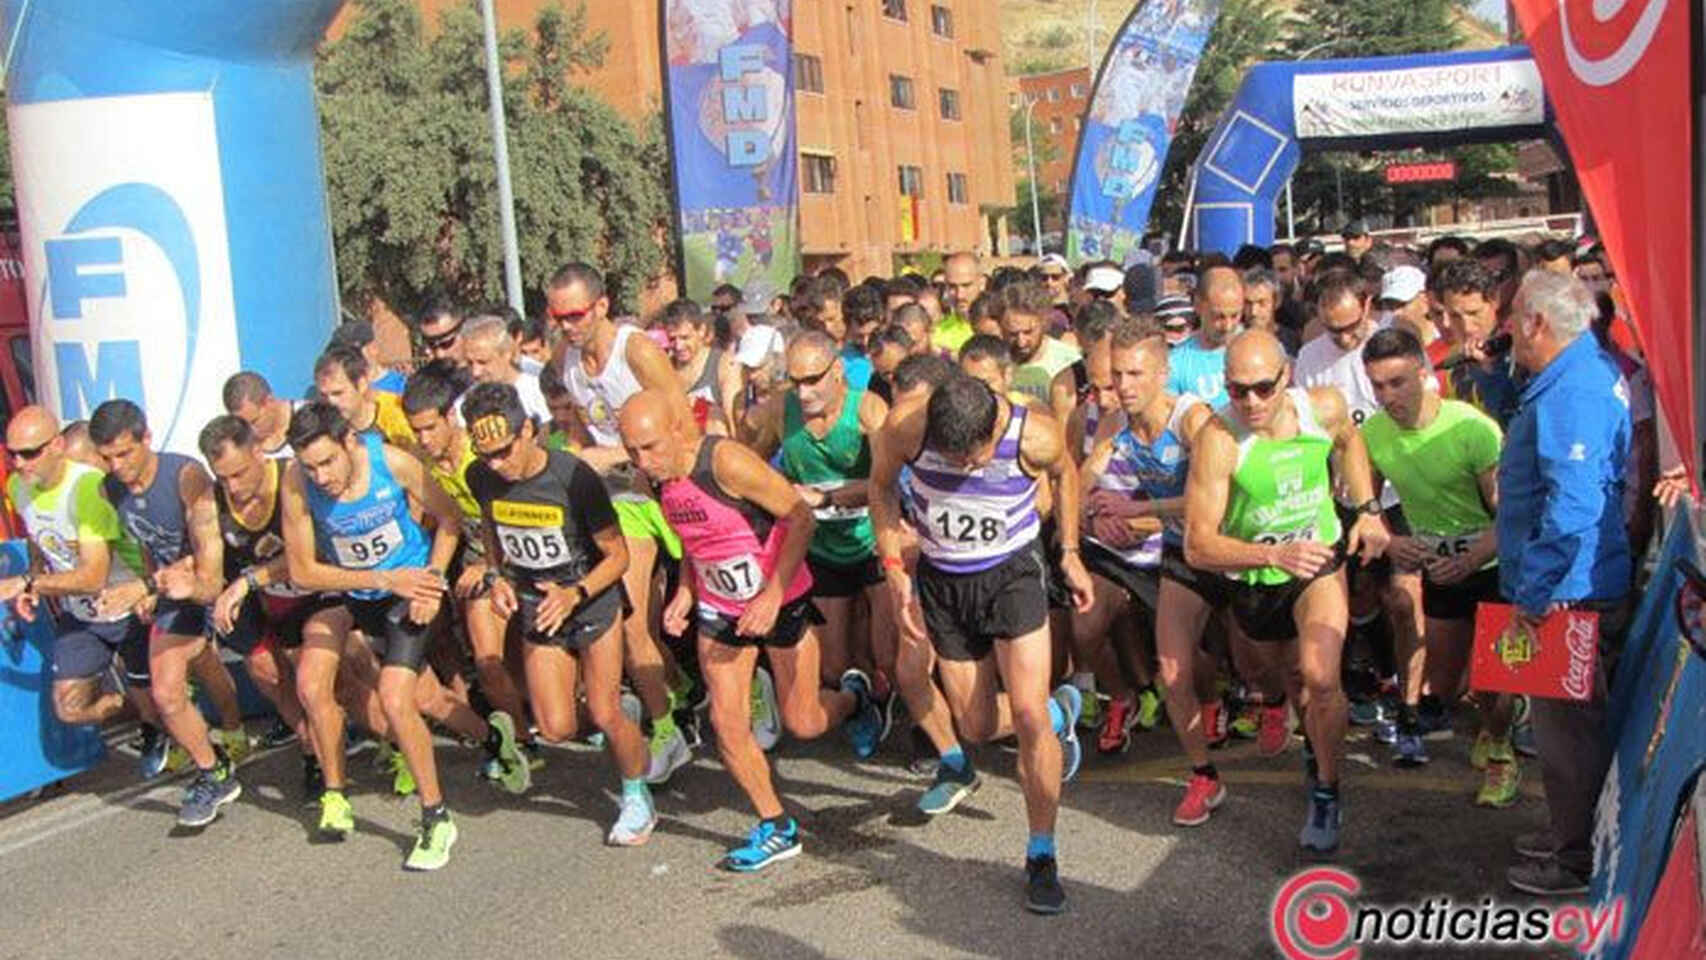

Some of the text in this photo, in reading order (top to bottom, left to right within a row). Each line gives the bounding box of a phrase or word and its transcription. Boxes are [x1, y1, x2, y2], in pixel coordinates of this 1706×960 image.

[1332, 64, 1502, 93] RUNVASPORT
[719, 42, 773, 168] FMD
[936, 511, 998, 543] 128
[350, 533, 389, 562] 95
[504, 533, 561, 561] 305
[705, 561, 753, 594] 107
